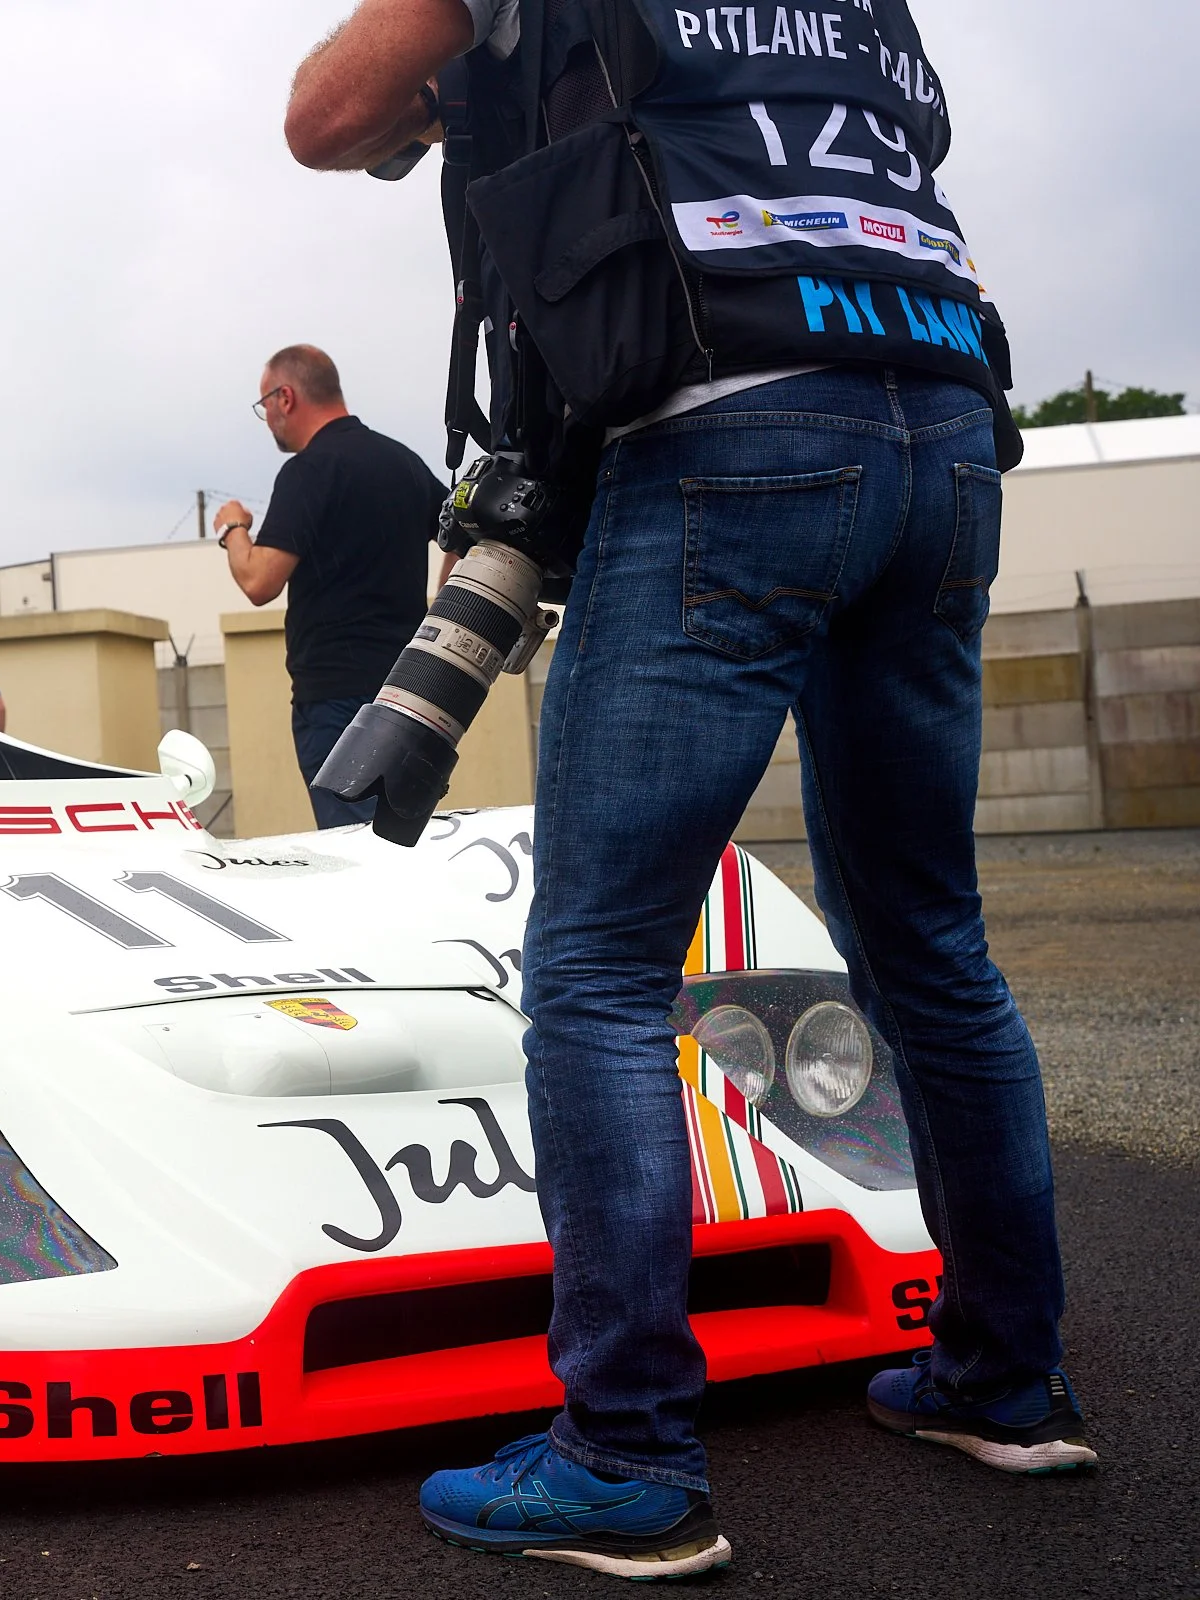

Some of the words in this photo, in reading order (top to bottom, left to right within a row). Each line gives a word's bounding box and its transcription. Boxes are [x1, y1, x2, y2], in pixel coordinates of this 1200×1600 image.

[675, 6, 847, 60] PITLANE
[784, 216, 840, 227] MICHELIN
[863, 223, 903, 240] MOTUL
[187, 848, 310, 871] Jules
[153, 967, 377, 994] Shell
[257, 1097, 537, 1252] Jul
